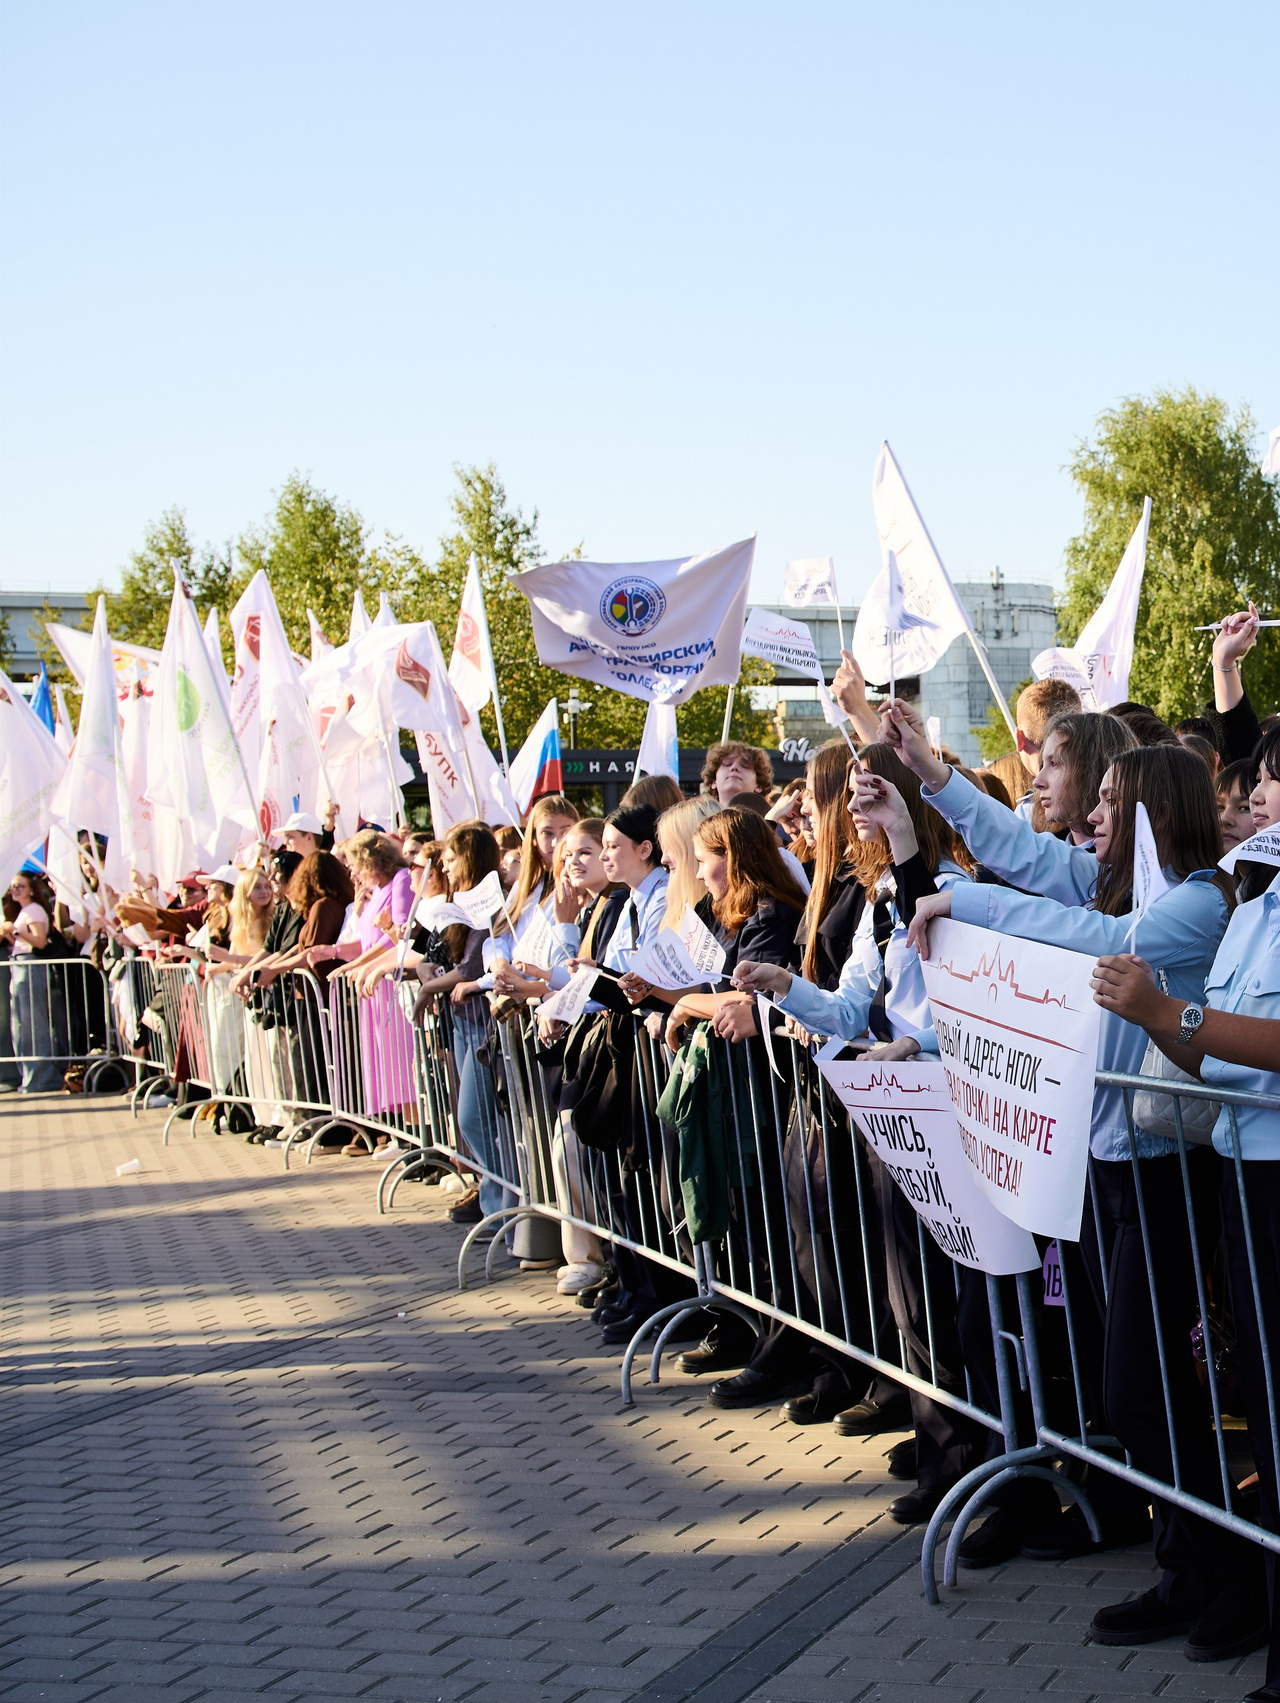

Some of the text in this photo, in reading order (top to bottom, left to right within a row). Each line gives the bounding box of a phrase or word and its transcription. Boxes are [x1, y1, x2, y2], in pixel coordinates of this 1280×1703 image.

[963, 1032, 1004, 1079] АДРЕС
[1004, 1048, 1042, 1094] НГОК
[862, 1112, 932, 1159] УЧИСЬ,
[961, 1080, 990, 1128] ТОЧКА
[992, 1096, 1009, 1137] НА
[1012, 1104, 1056, 1156] КАРТЕ
[979, 1140, 1022, 1198] УСПЕХА!
